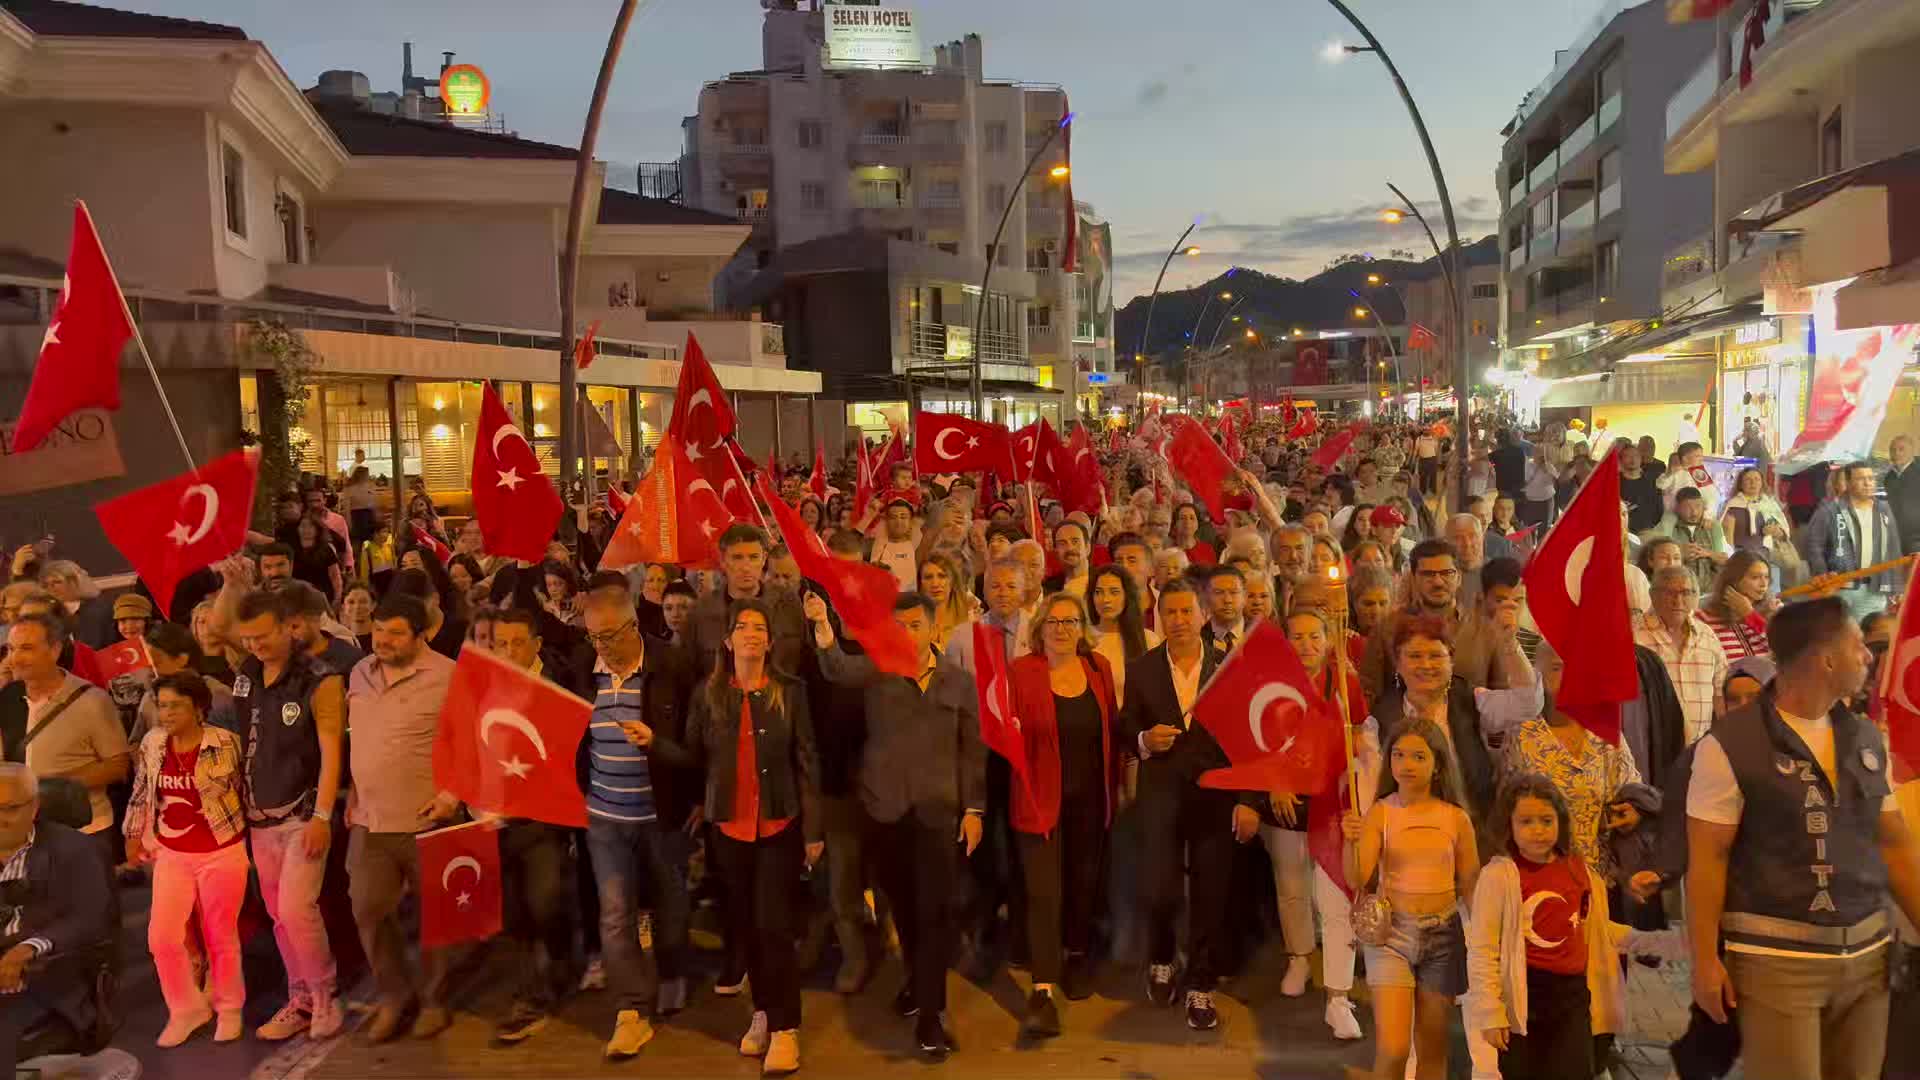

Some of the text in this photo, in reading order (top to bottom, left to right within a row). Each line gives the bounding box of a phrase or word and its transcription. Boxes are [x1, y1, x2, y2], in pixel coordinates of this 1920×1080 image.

[833, 10, 911, 26] SELEN HOTEL
[1796, 760, 1836, 912] ZABITA
